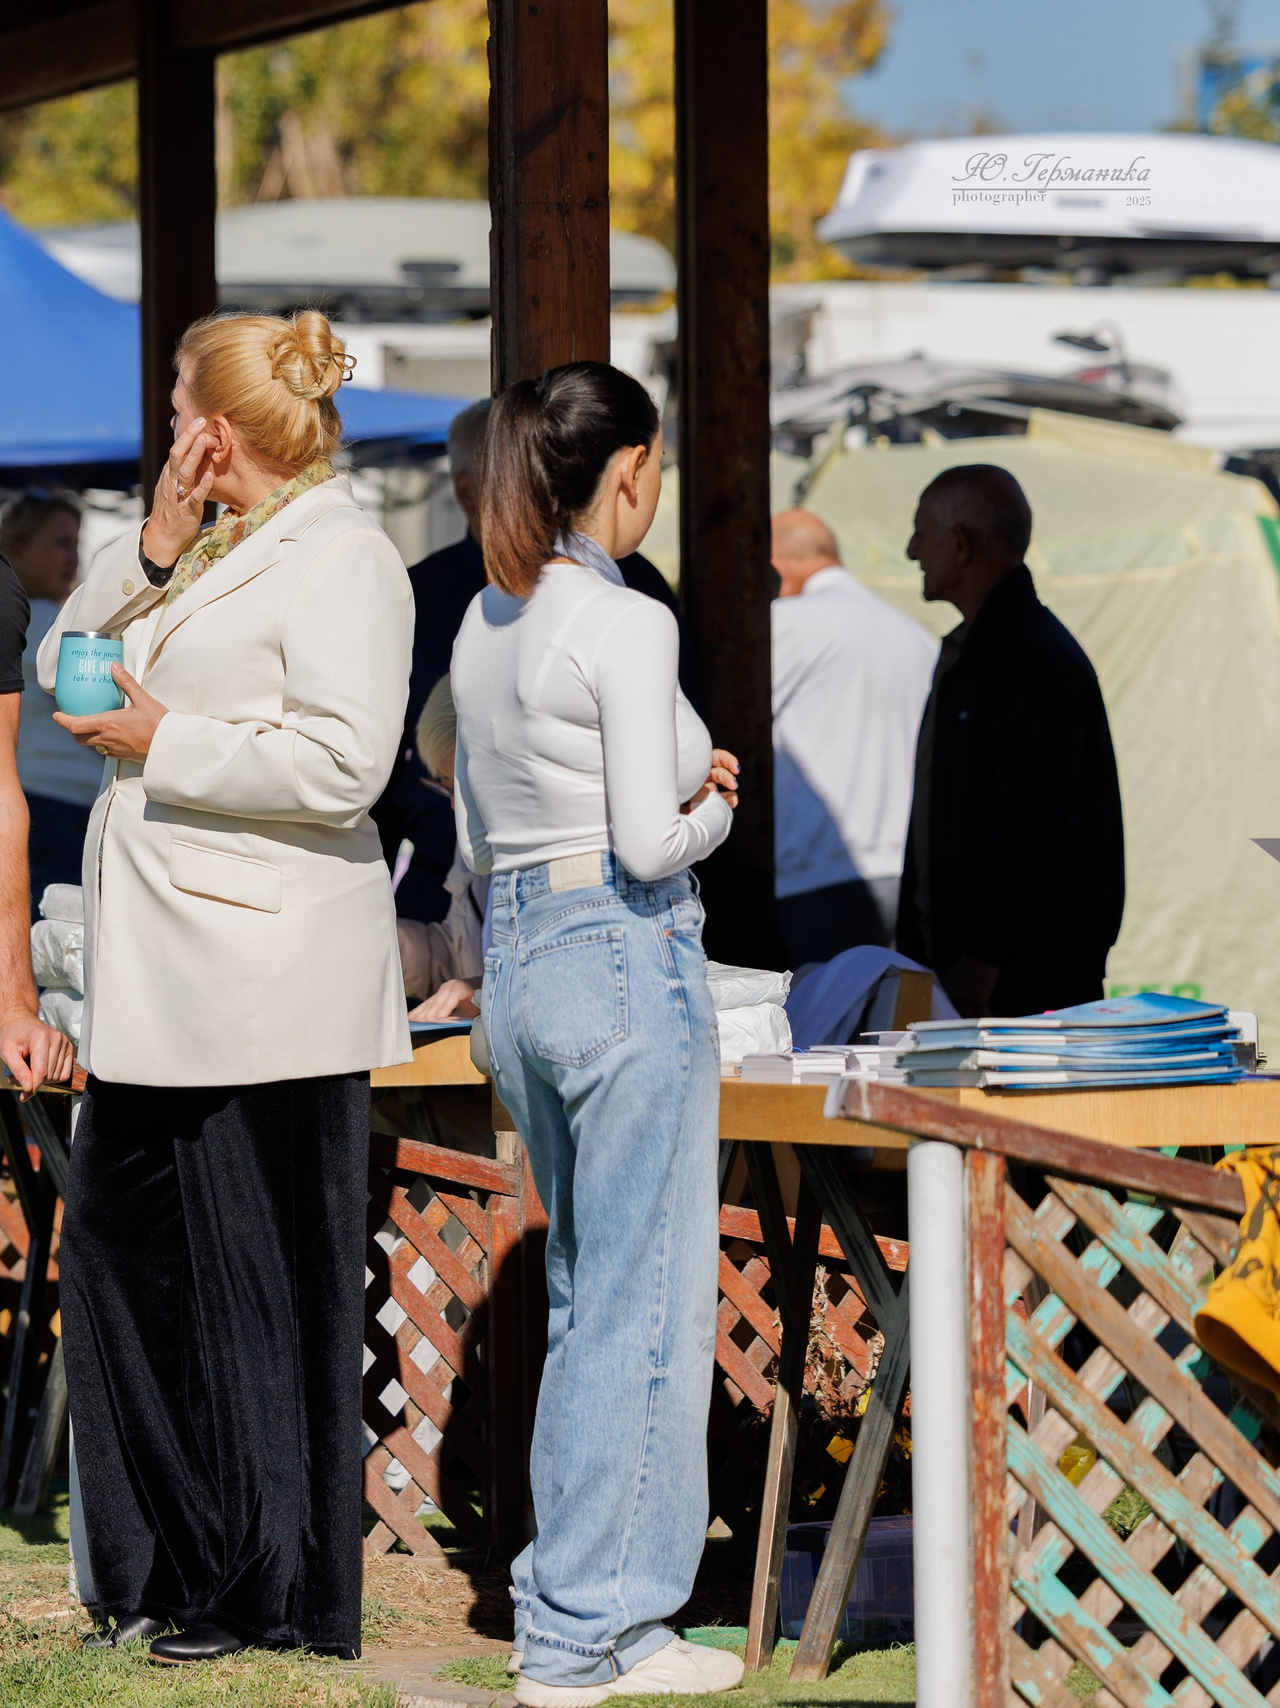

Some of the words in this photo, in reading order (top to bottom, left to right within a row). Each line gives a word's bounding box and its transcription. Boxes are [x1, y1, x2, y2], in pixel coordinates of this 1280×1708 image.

[71, 649, 88, 658] enjoy
[91, 649, 102, 657] the
[79, 659, 97, 674] GIVE
[73, 674, 89, 682] take
[99, 675, 114, 684] cha
